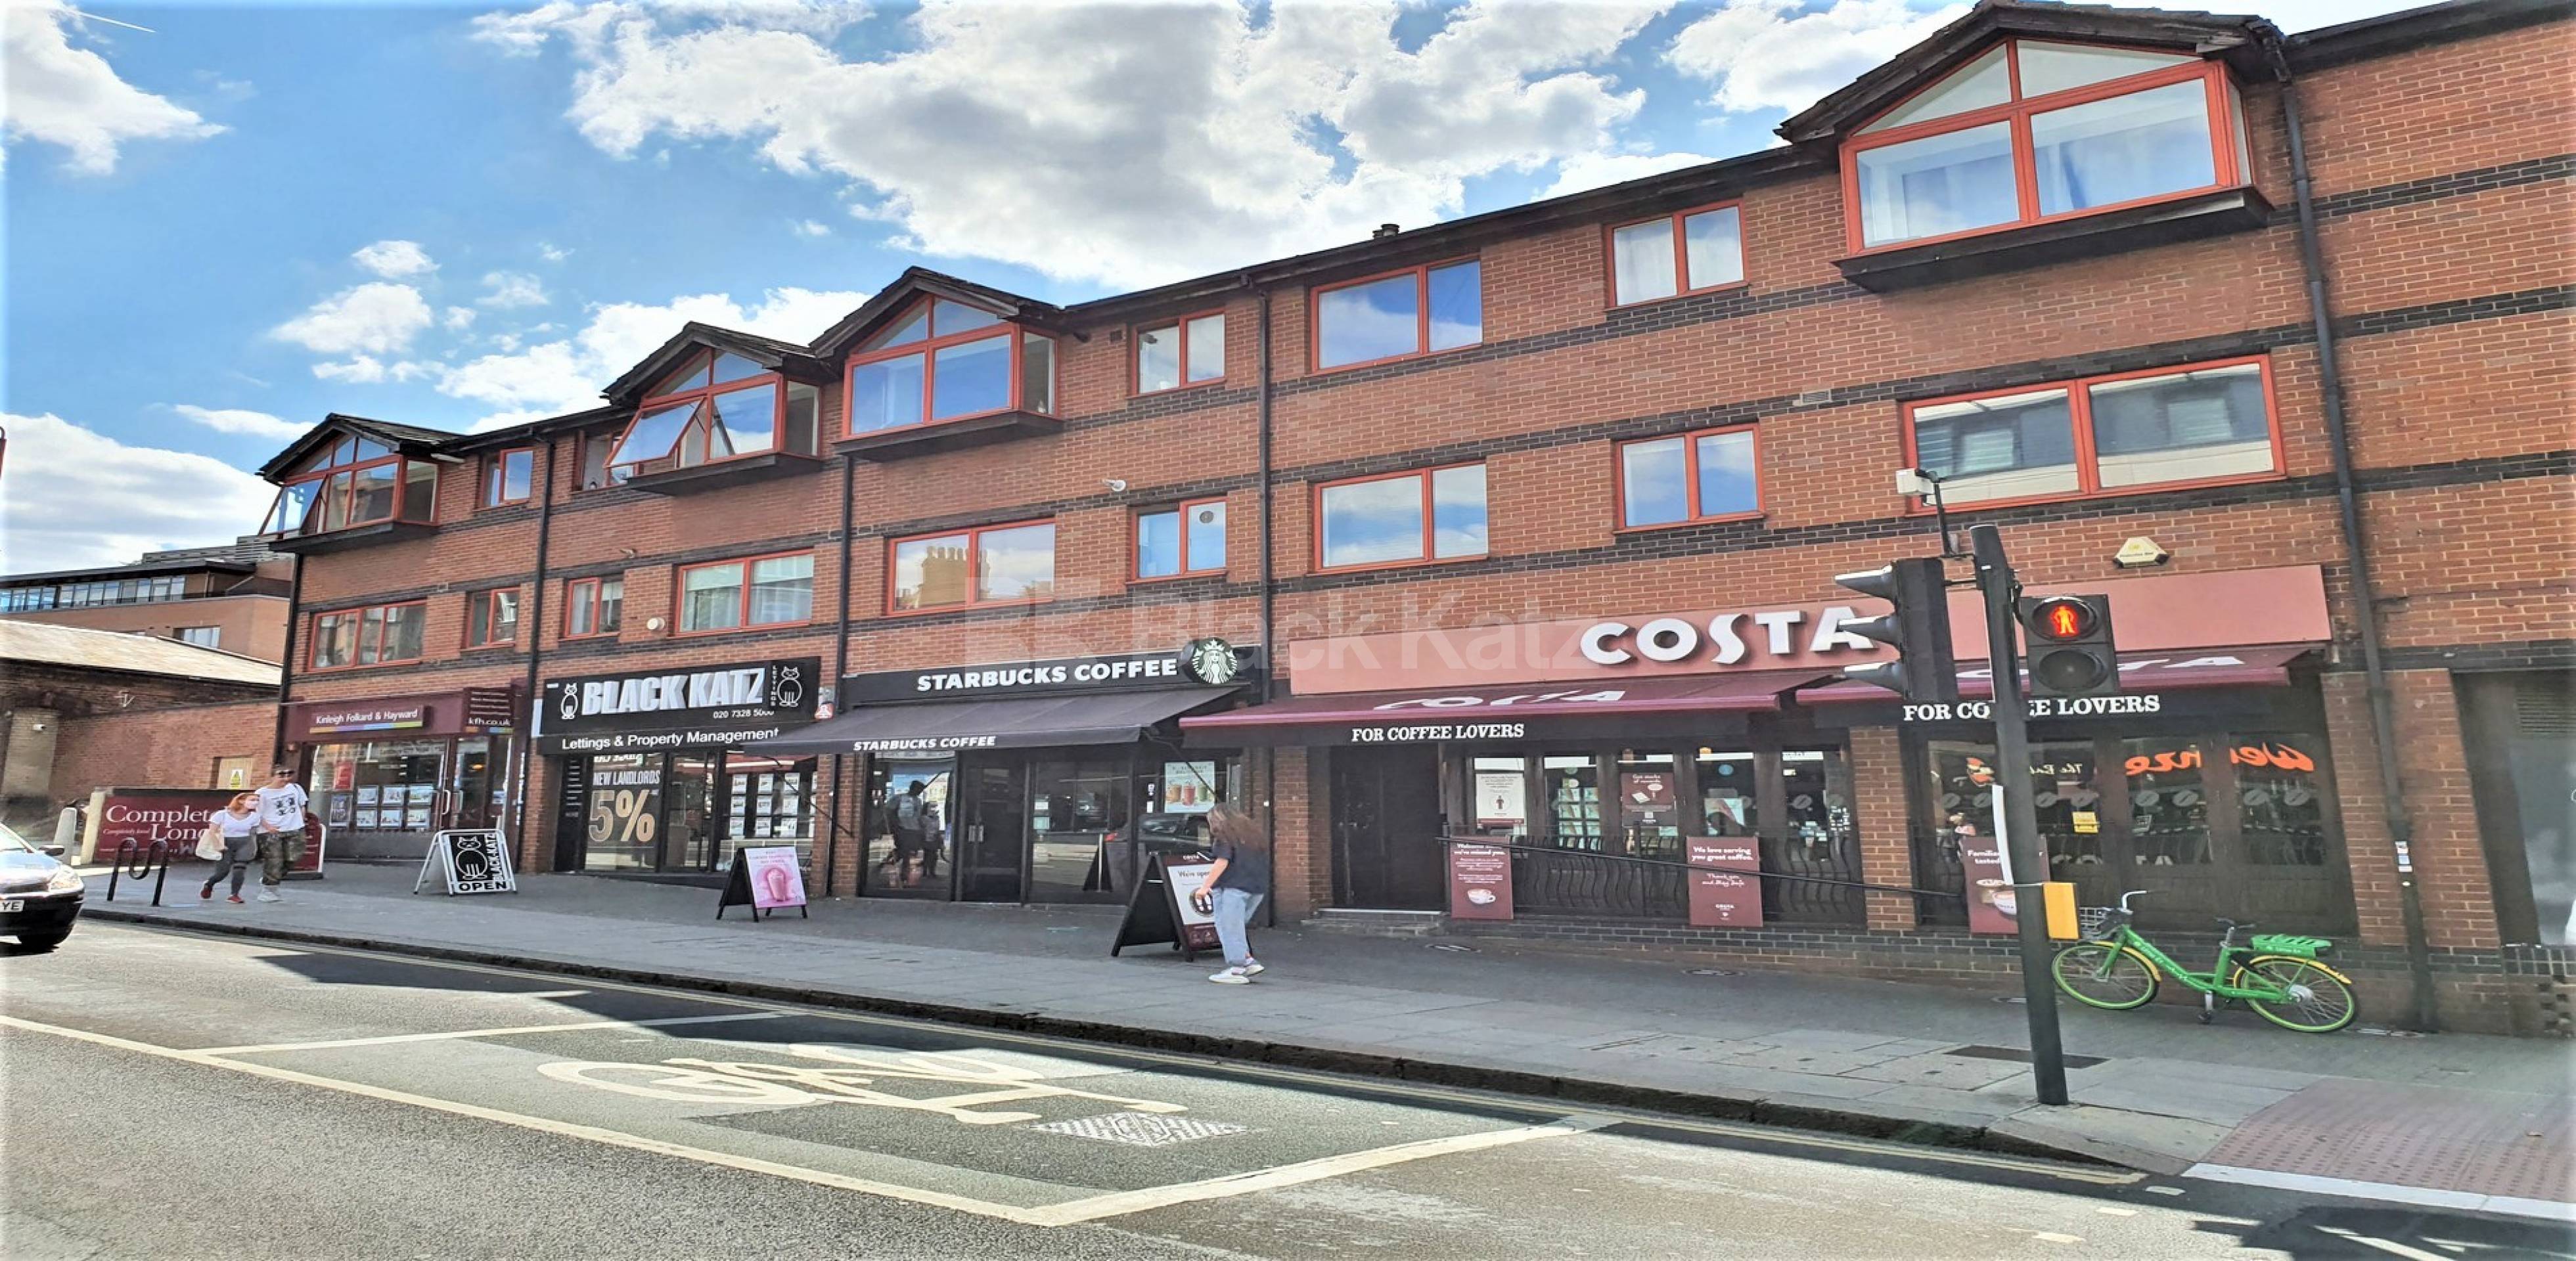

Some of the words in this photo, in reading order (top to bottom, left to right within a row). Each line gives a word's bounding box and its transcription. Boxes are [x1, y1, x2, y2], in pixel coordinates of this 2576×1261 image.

[1580, 606, 1874, 665] COSTA
[917, 667, 1066, 691] STARBUCKS
[1074, 659, 1177, 681] COFFEE
[581, 675, 689, 715] BLACK
[689, 668, 765, 707] KATZ
[384, 709, 418, 720] Hayward
[1903, 704, 1951, 720] FOR
[1957, 699, 2050, 719] COE
[2058, 695, 2160, 715] LOVERS
[562, 738, 610, 750] Lettings
[614, 737, 623, 746] &
[628, 732, 683, 747] Property
[687, 727, 779, 743] Management
[853, 738, 936, 751] STARBUCKS
[940, 736, 996, 749] COFFEE
[1351, 728, 1384, 741] FOR
[1388, 726, 1452, 741] COFFEE
[1455, 723, 1524, 738] LOVERS
[593, 772, 612, 785] NEW
[613, 770, 660, 785] LANDLORDS
[106, 805, 212, 828] Complet
[589, 789, 655, 842] 5%
[460, 882, 506, 891] OPEN
